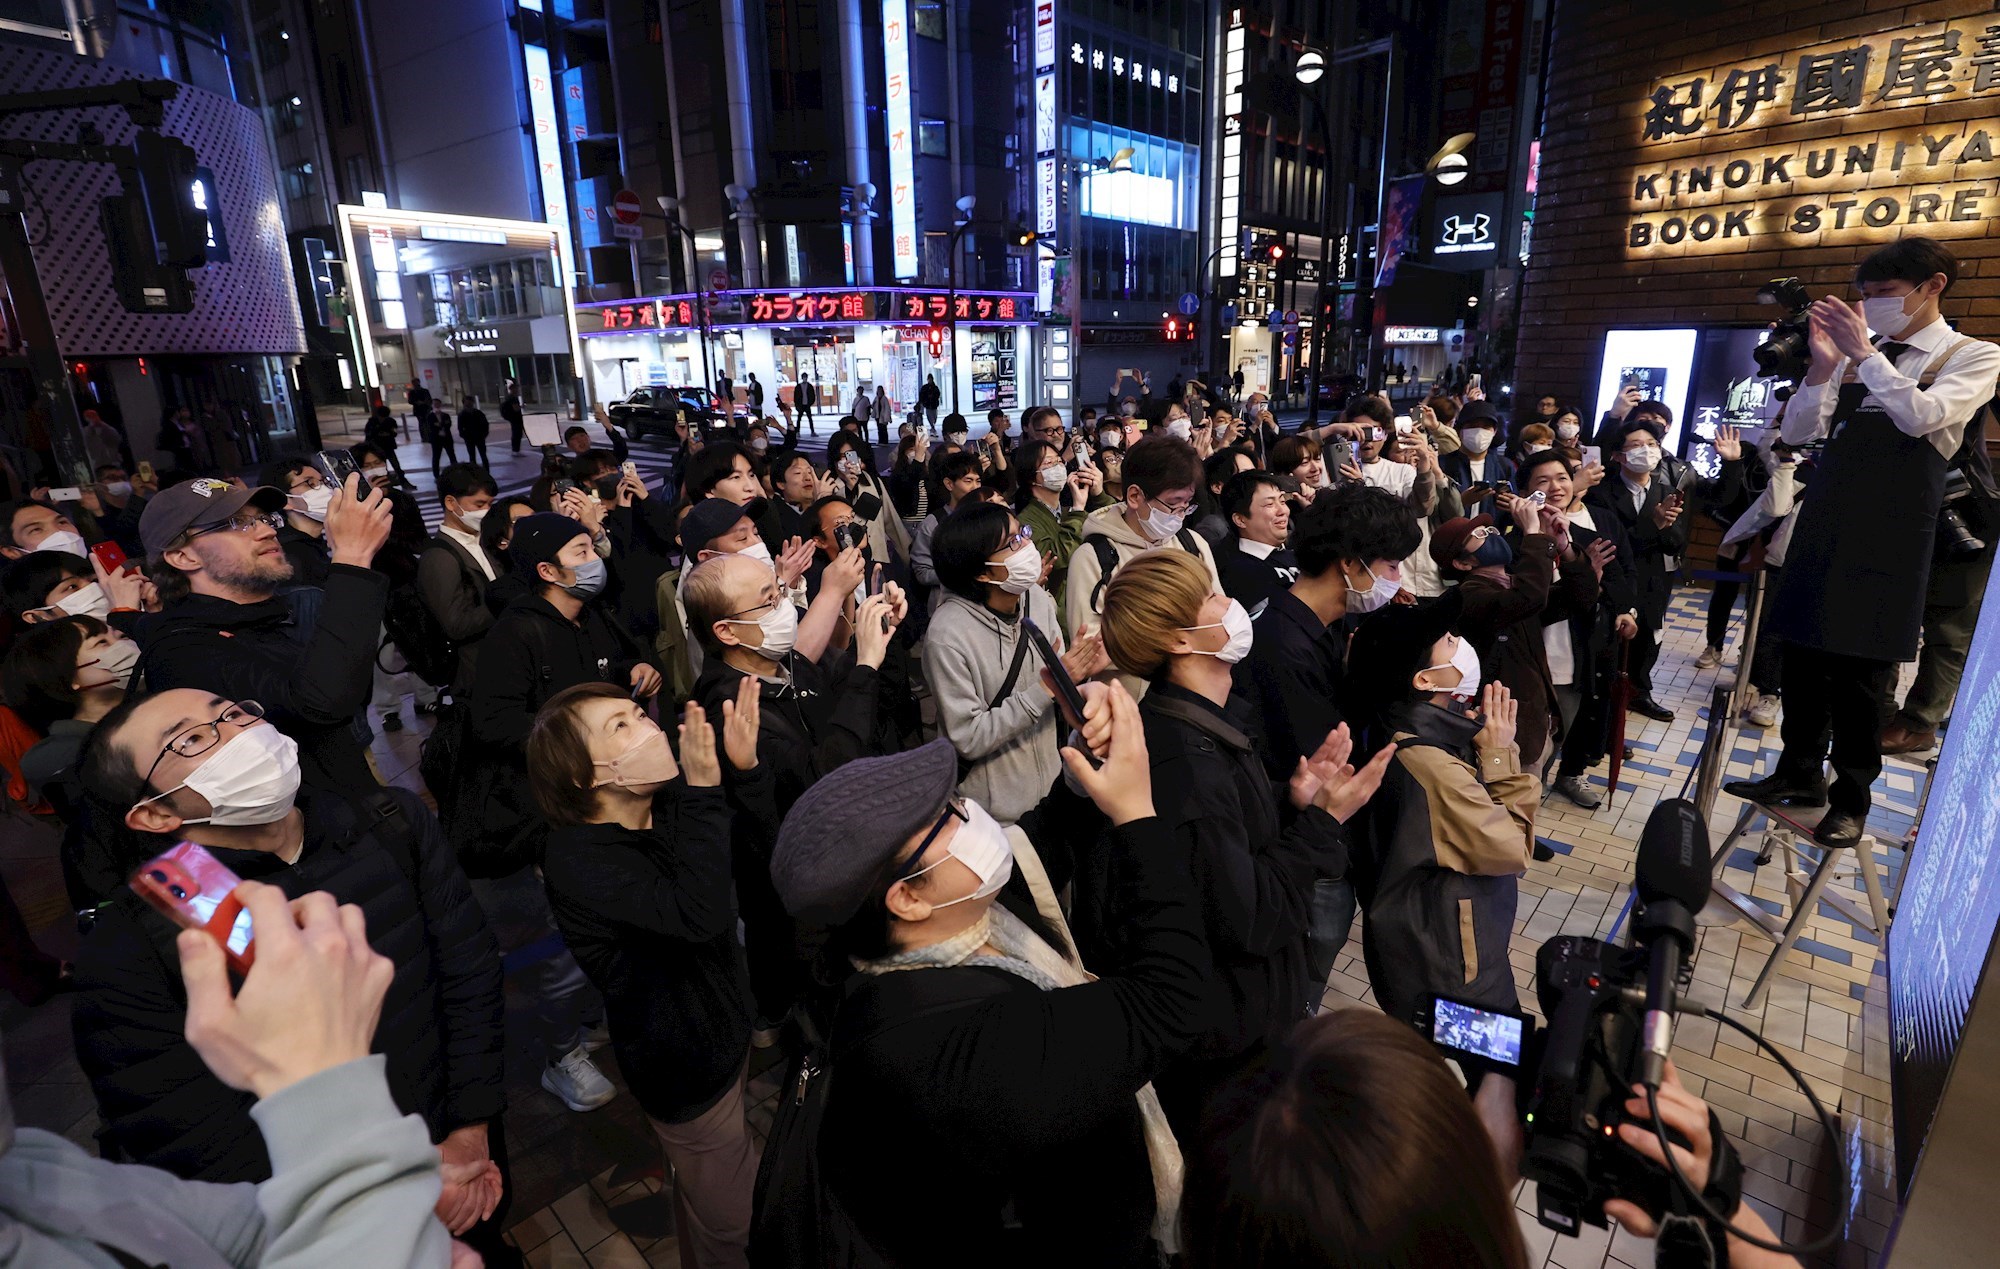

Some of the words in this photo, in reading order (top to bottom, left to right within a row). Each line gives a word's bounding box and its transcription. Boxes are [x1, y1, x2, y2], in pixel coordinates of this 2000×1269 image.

[887, 20, 910, 256] カラオケ館
[1634, 130, 1994, 201] KINOKUNIYA
[1045, 161, 1053, 230] サンドラッグ
[1629, 210, 1752, 248] BOOK
[1790, 188, 1987, 234] STORE
[752, 296, 864, 320] カラオケ館
[907, 296, 1015, 318] カラオケ館
